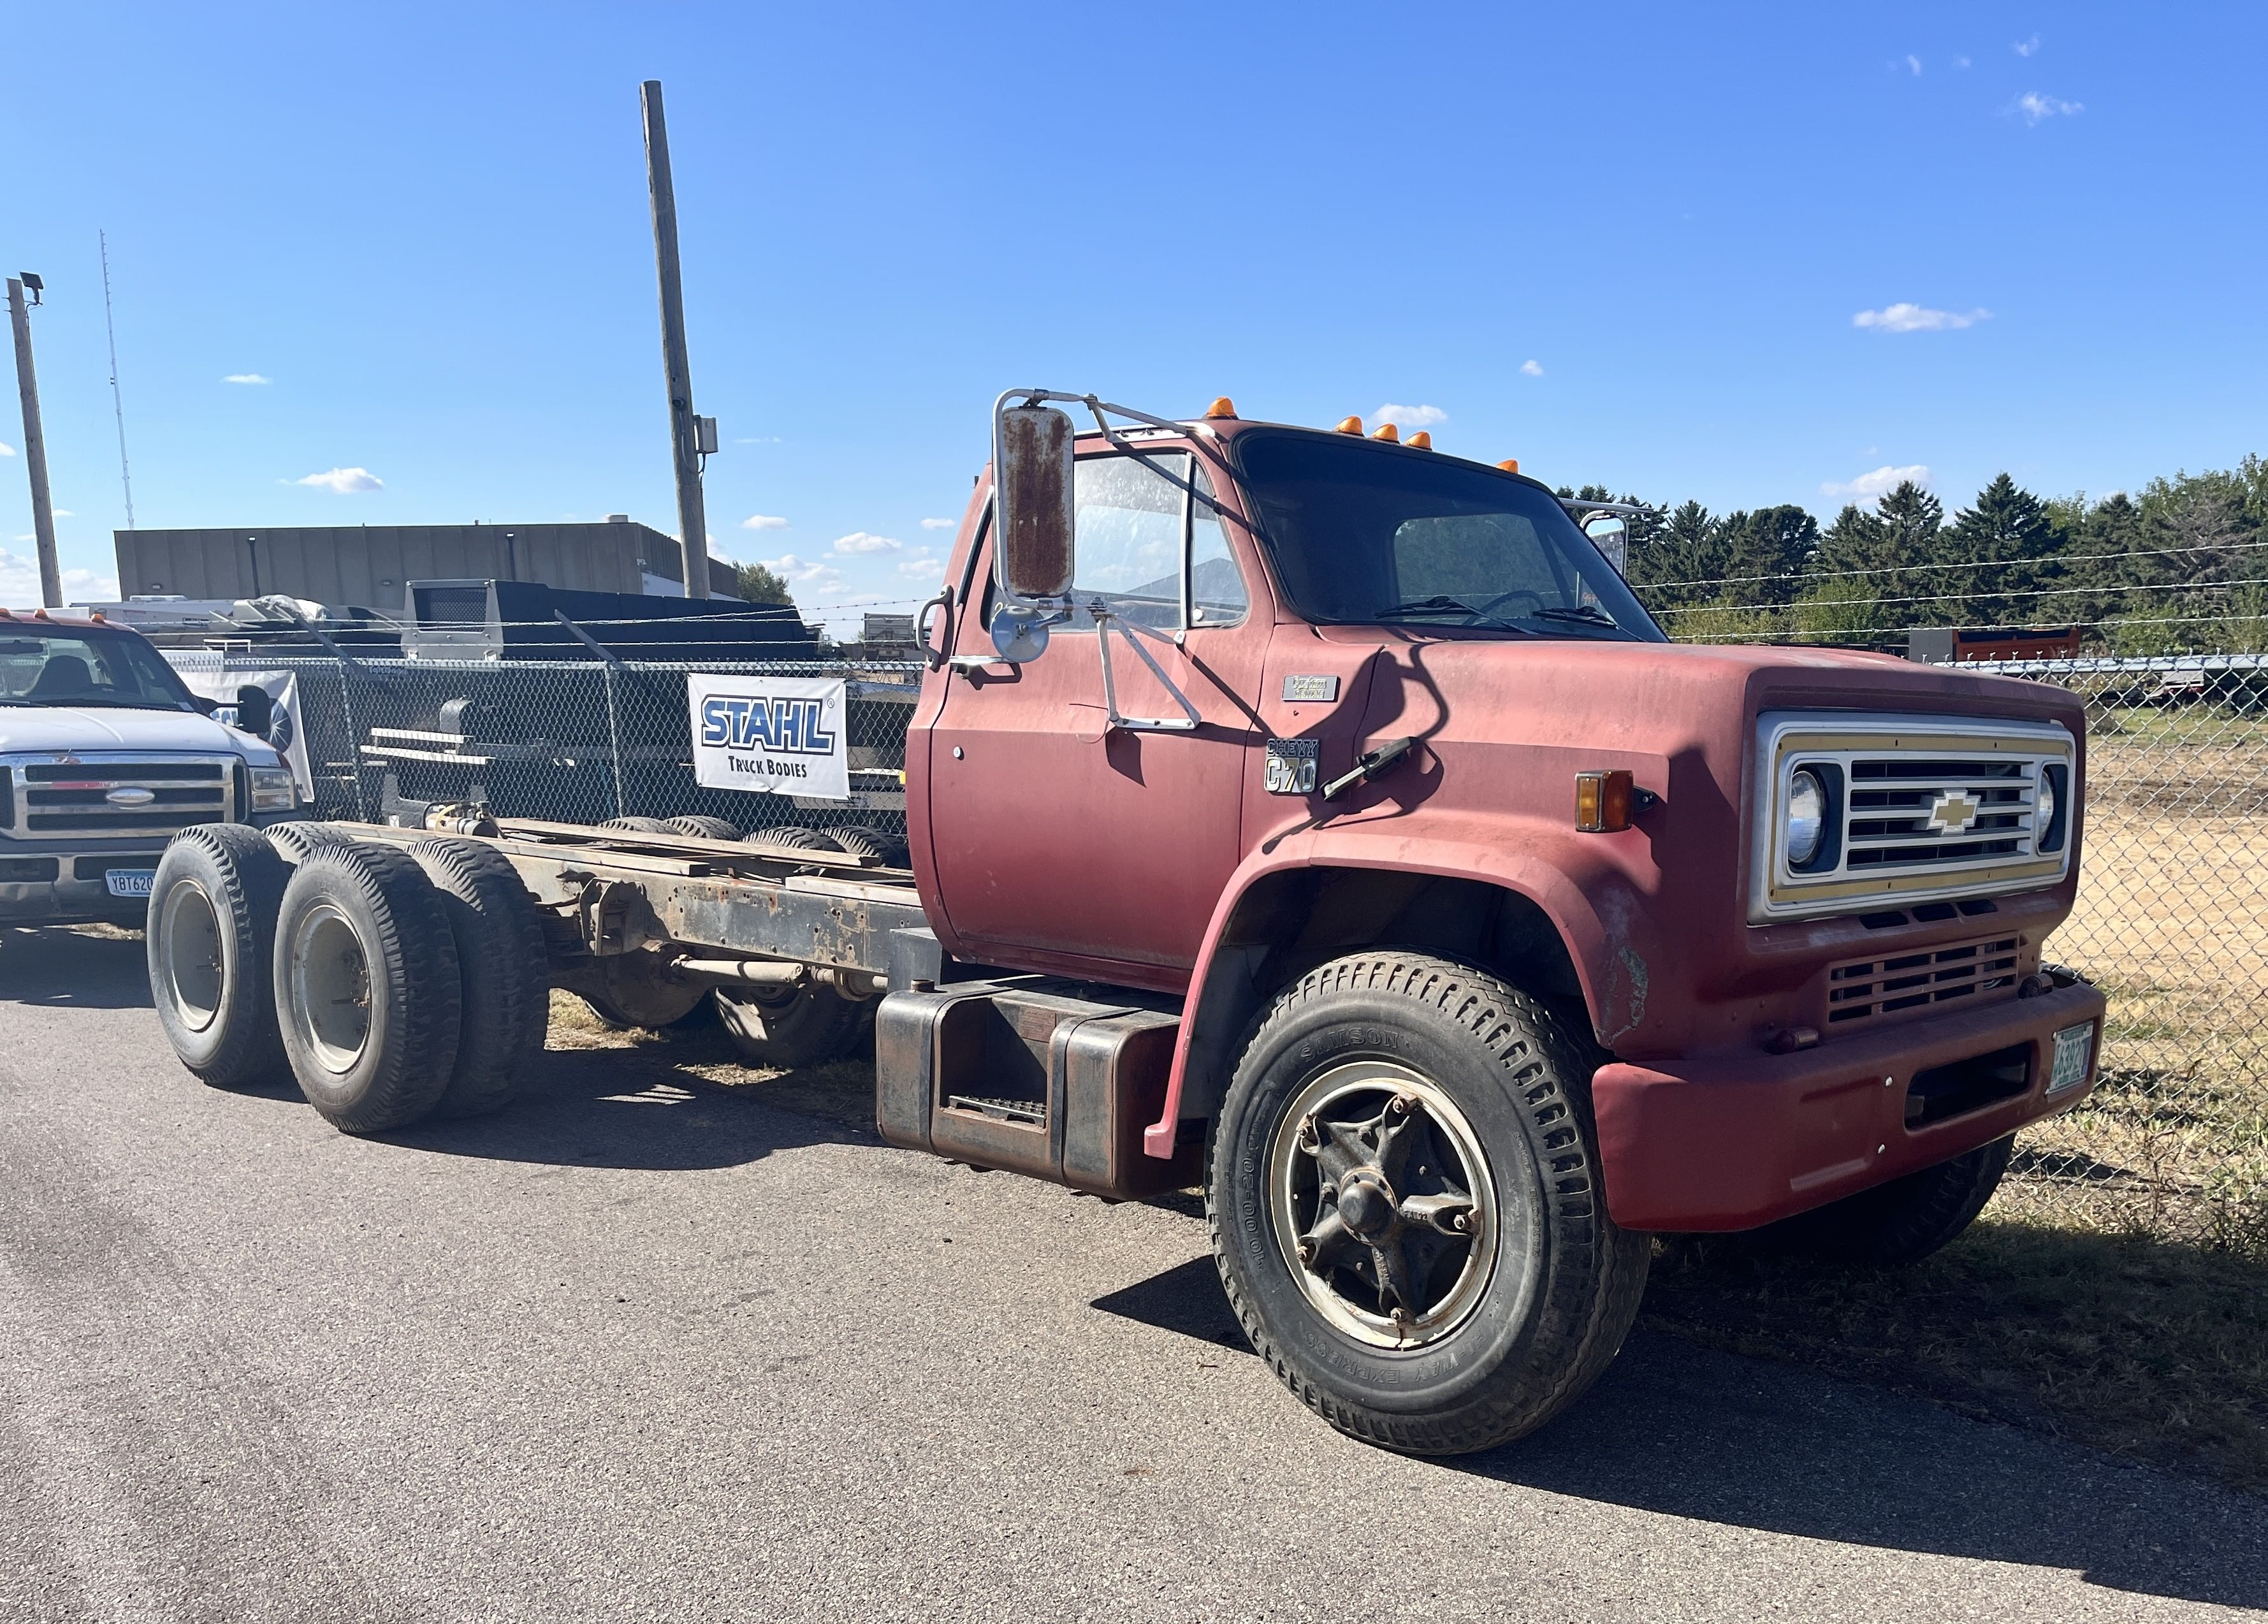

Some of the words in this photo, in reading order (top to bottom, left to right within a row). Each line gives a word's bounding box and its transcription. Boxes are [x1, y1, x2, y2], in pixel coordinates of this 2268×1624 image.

[701, 694, 836, 755] STAHL
[1267, 739, 1318, 757] CHEVY
[1265, 757, 1317, 792] C70
[112, 877, 153, 891] YBT620
[1300, 1027, 1399, 1062] SAMSON
